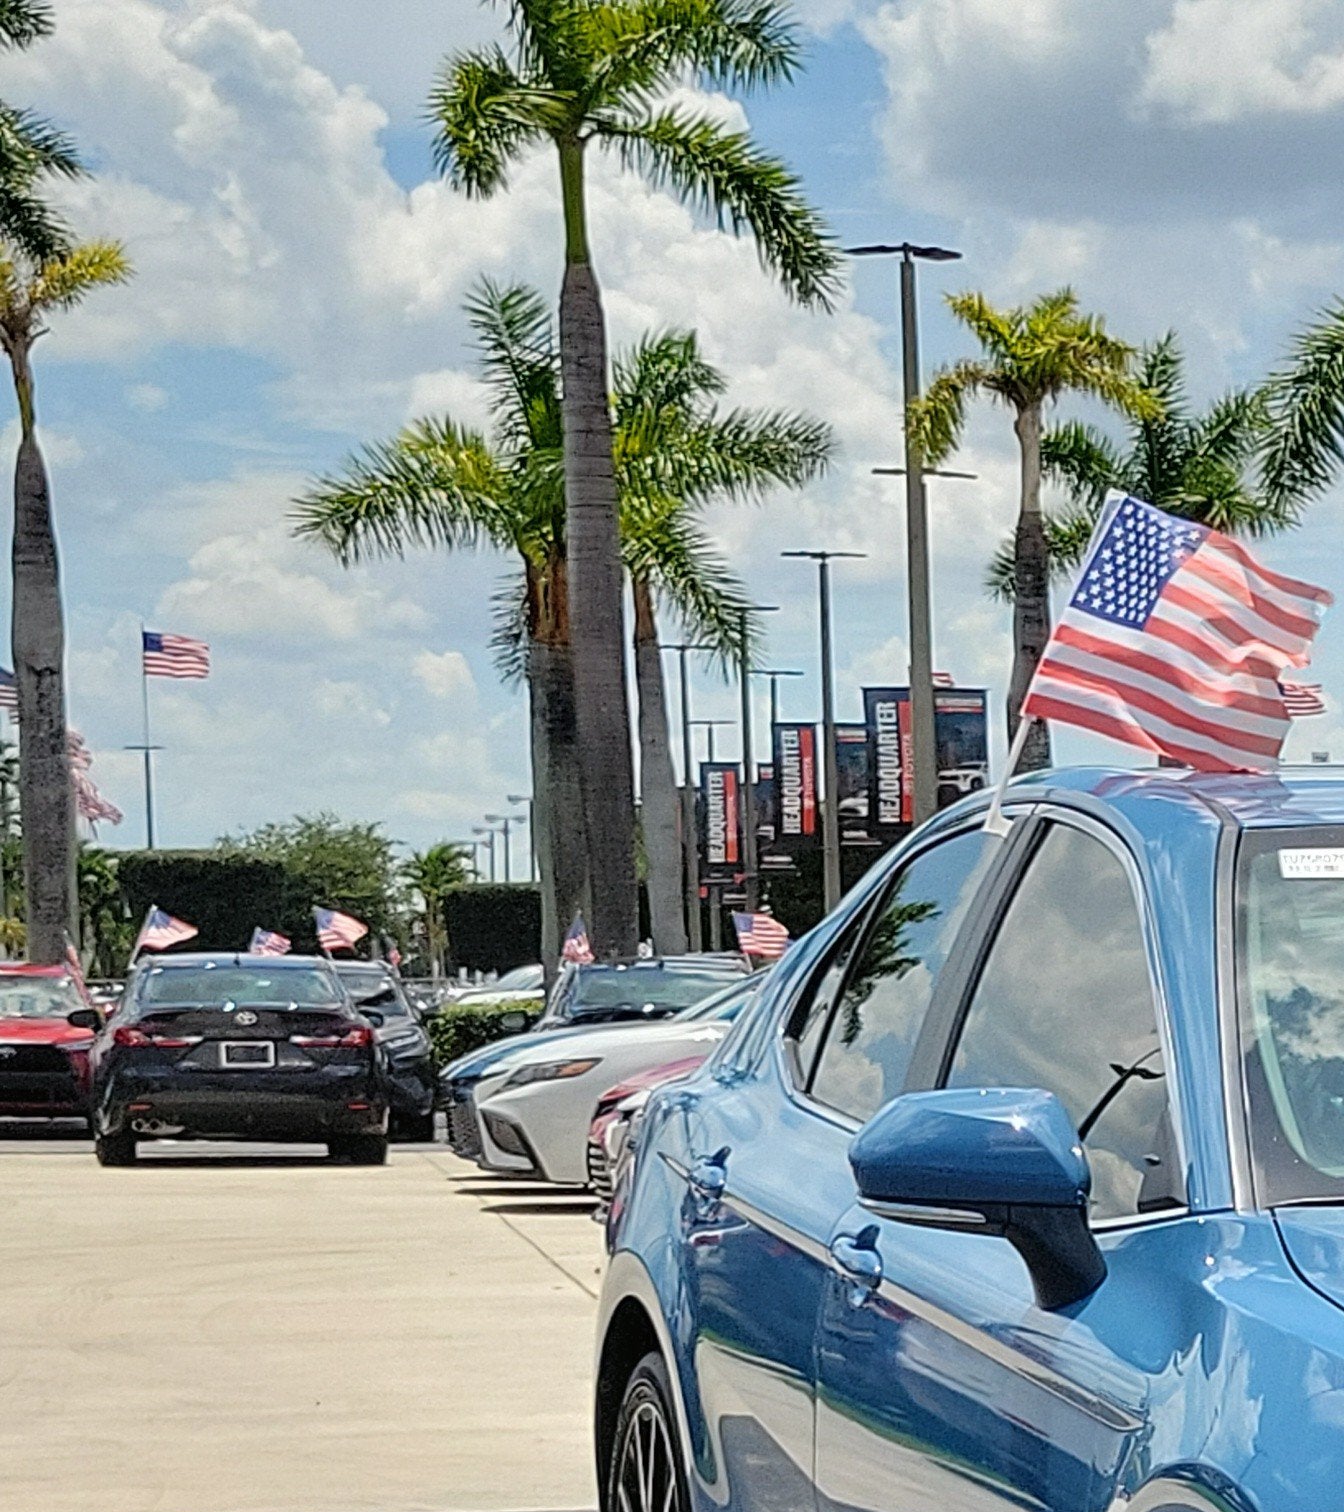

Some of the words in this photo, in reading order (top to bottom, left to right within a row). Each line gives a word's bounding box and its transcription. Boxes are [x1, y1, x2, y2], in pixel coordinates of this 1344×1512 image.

[781, 730, 803, 834] HEADQUARTER
[876, 701, 902, 824] HEADQUARTER
[707, 771, 727, 864] HEADQUARTER
